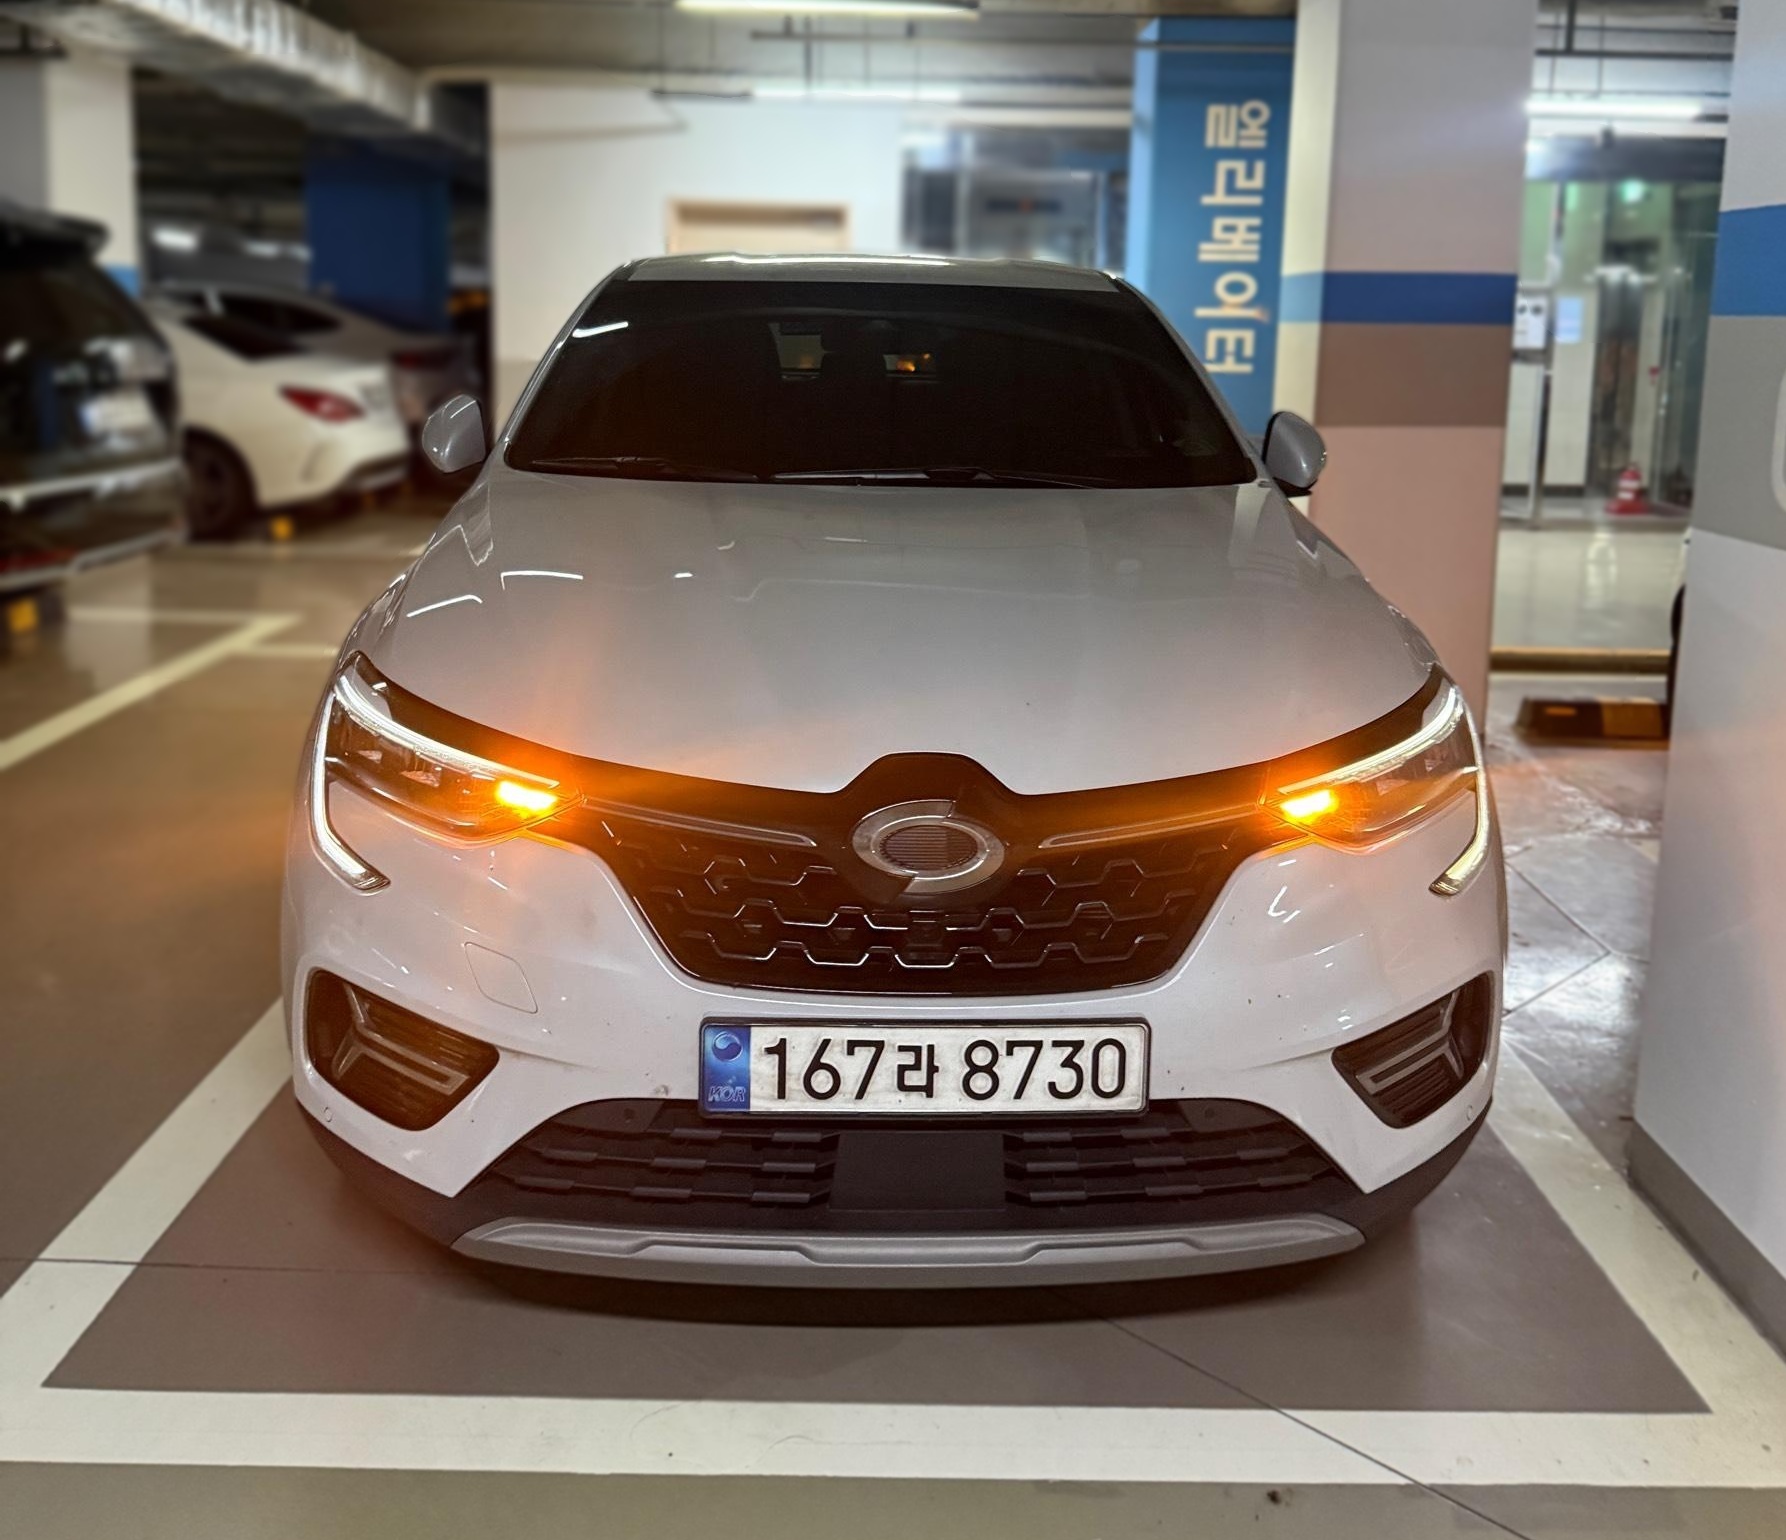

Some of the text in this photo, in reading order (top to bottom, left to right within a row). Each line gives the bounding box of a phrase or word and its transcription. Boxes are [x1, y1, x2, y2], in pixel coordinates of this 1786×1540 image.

[1194, 99, 1271, 374] 엘리베이터
[707, 1085, 746, 1102] KOR
[763, 1037, 1128, 1100] 167라 8730
